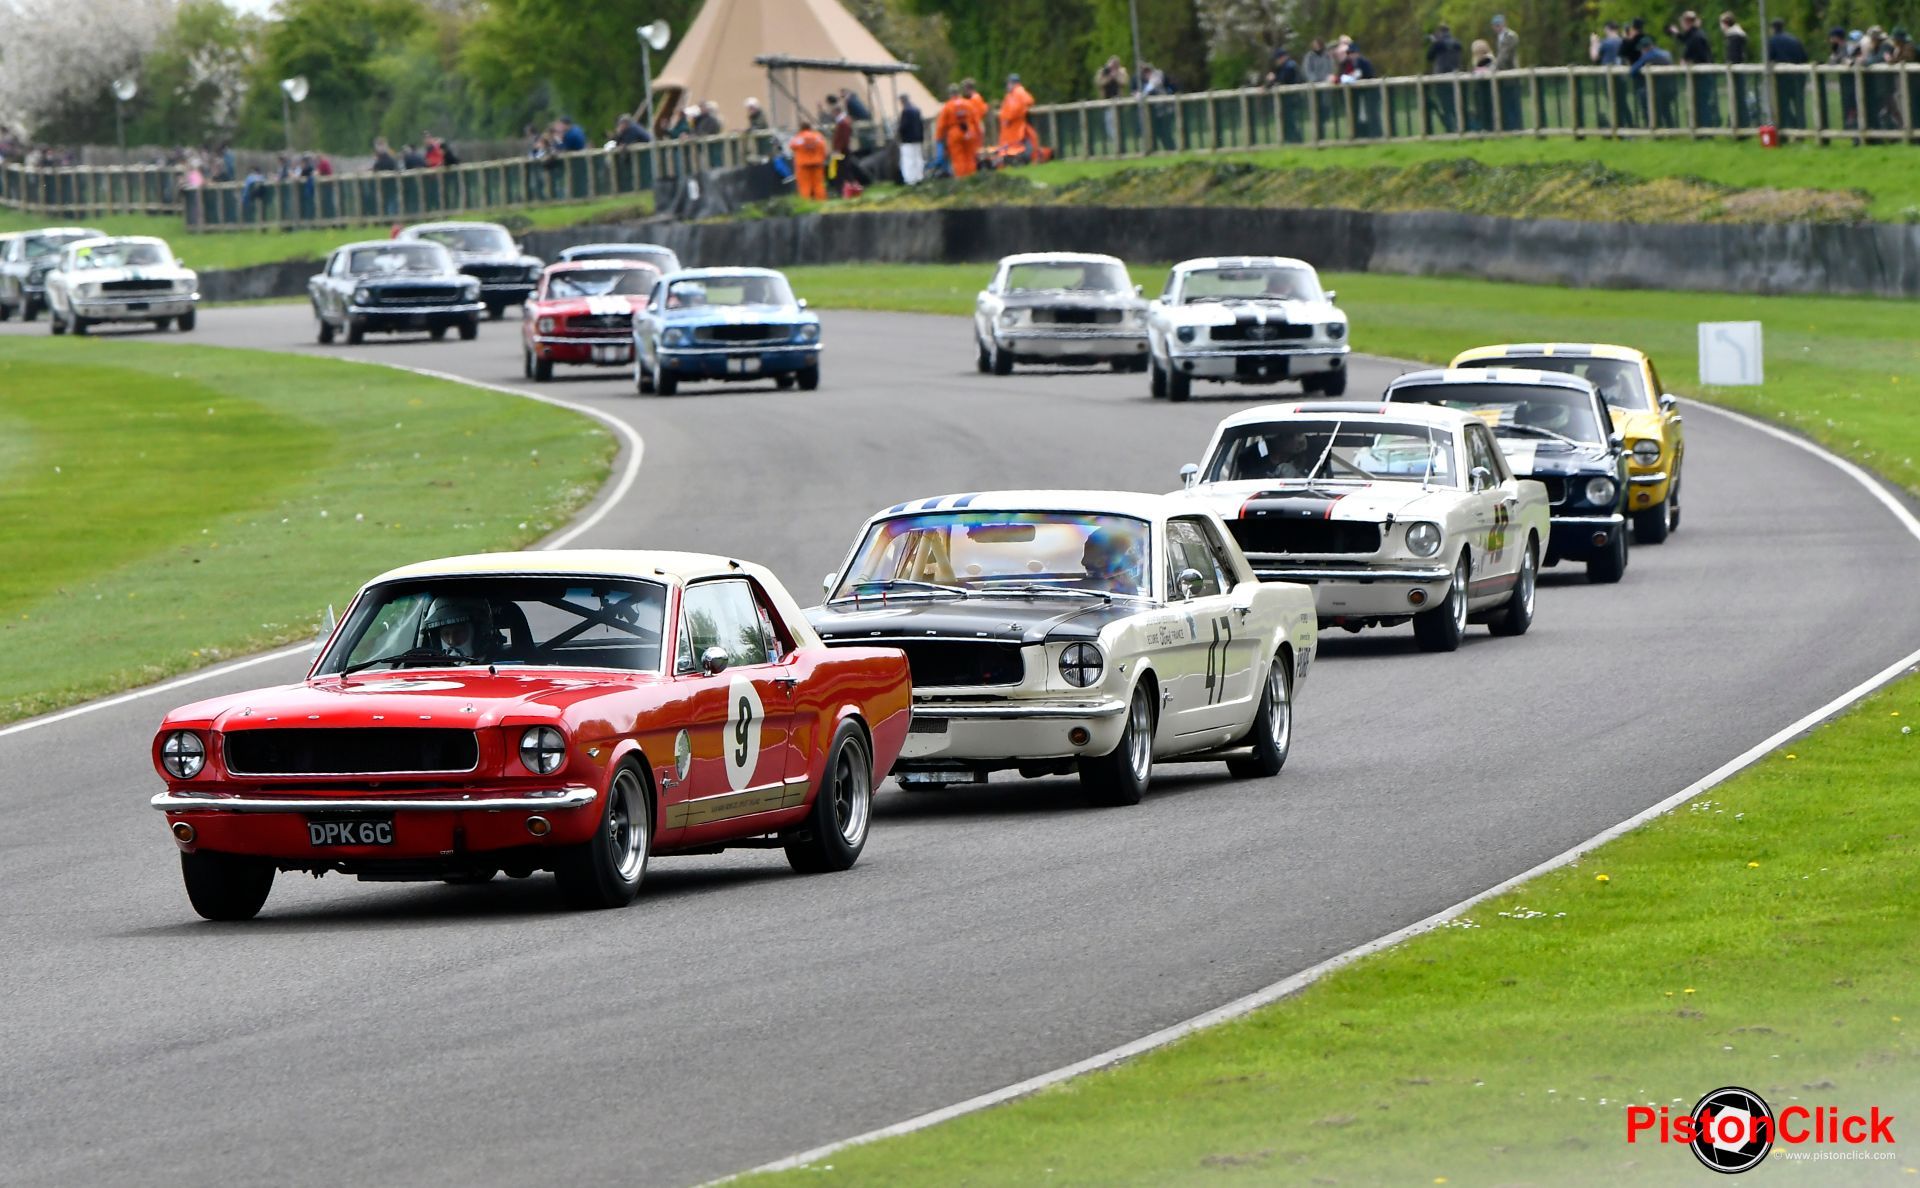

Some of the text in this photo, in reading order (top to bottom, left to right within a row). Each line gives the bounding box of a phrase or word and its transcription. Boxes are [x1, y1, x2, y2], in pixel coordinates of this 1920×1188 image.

[1205, 616, 1231, 705] 47
[735, 696, 753, 767] 9
[310, 822, 392, 845] DPK 6C
